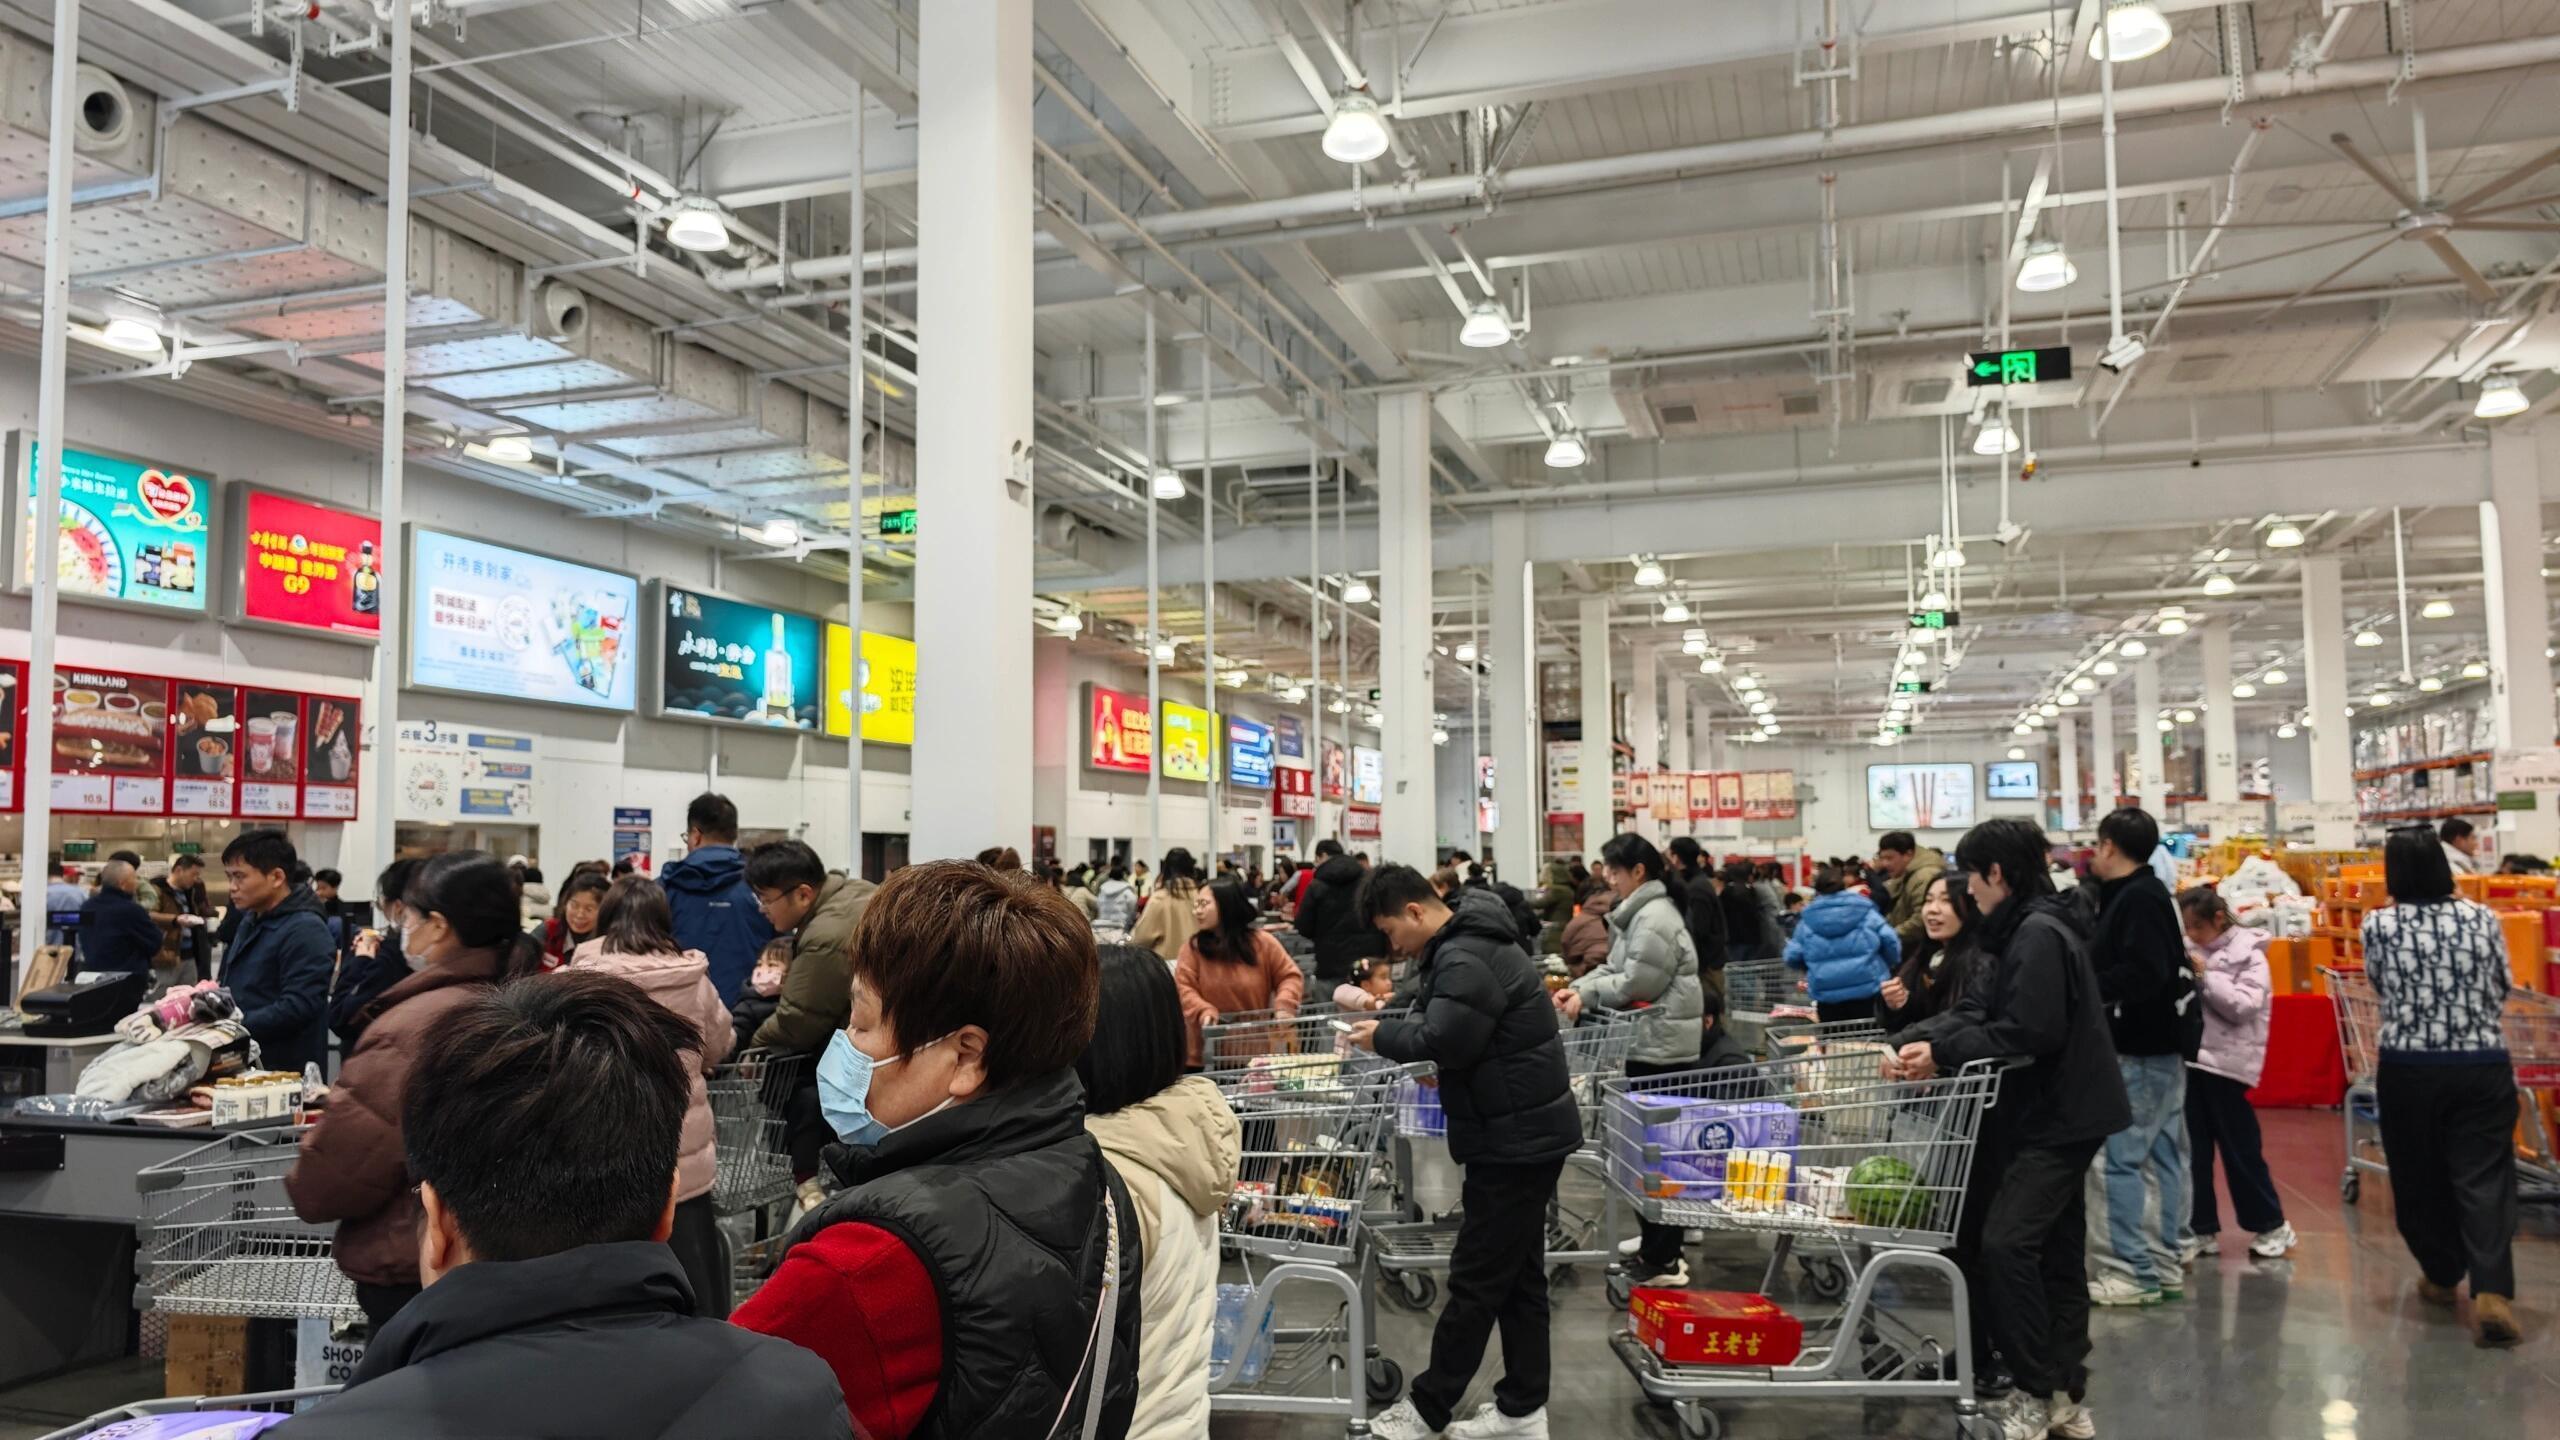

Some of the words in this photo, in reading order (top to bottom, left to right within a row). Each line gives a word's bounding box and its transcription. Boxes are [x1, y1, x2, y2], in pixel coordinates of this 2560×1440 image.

[72, 672, 128, 689] KIRKLAND
[83, 794, 103, 804] 10.9
[1702, 1331, 1762, 1356] 王老吉
[322, 1346, 363, 1363] SHOP
